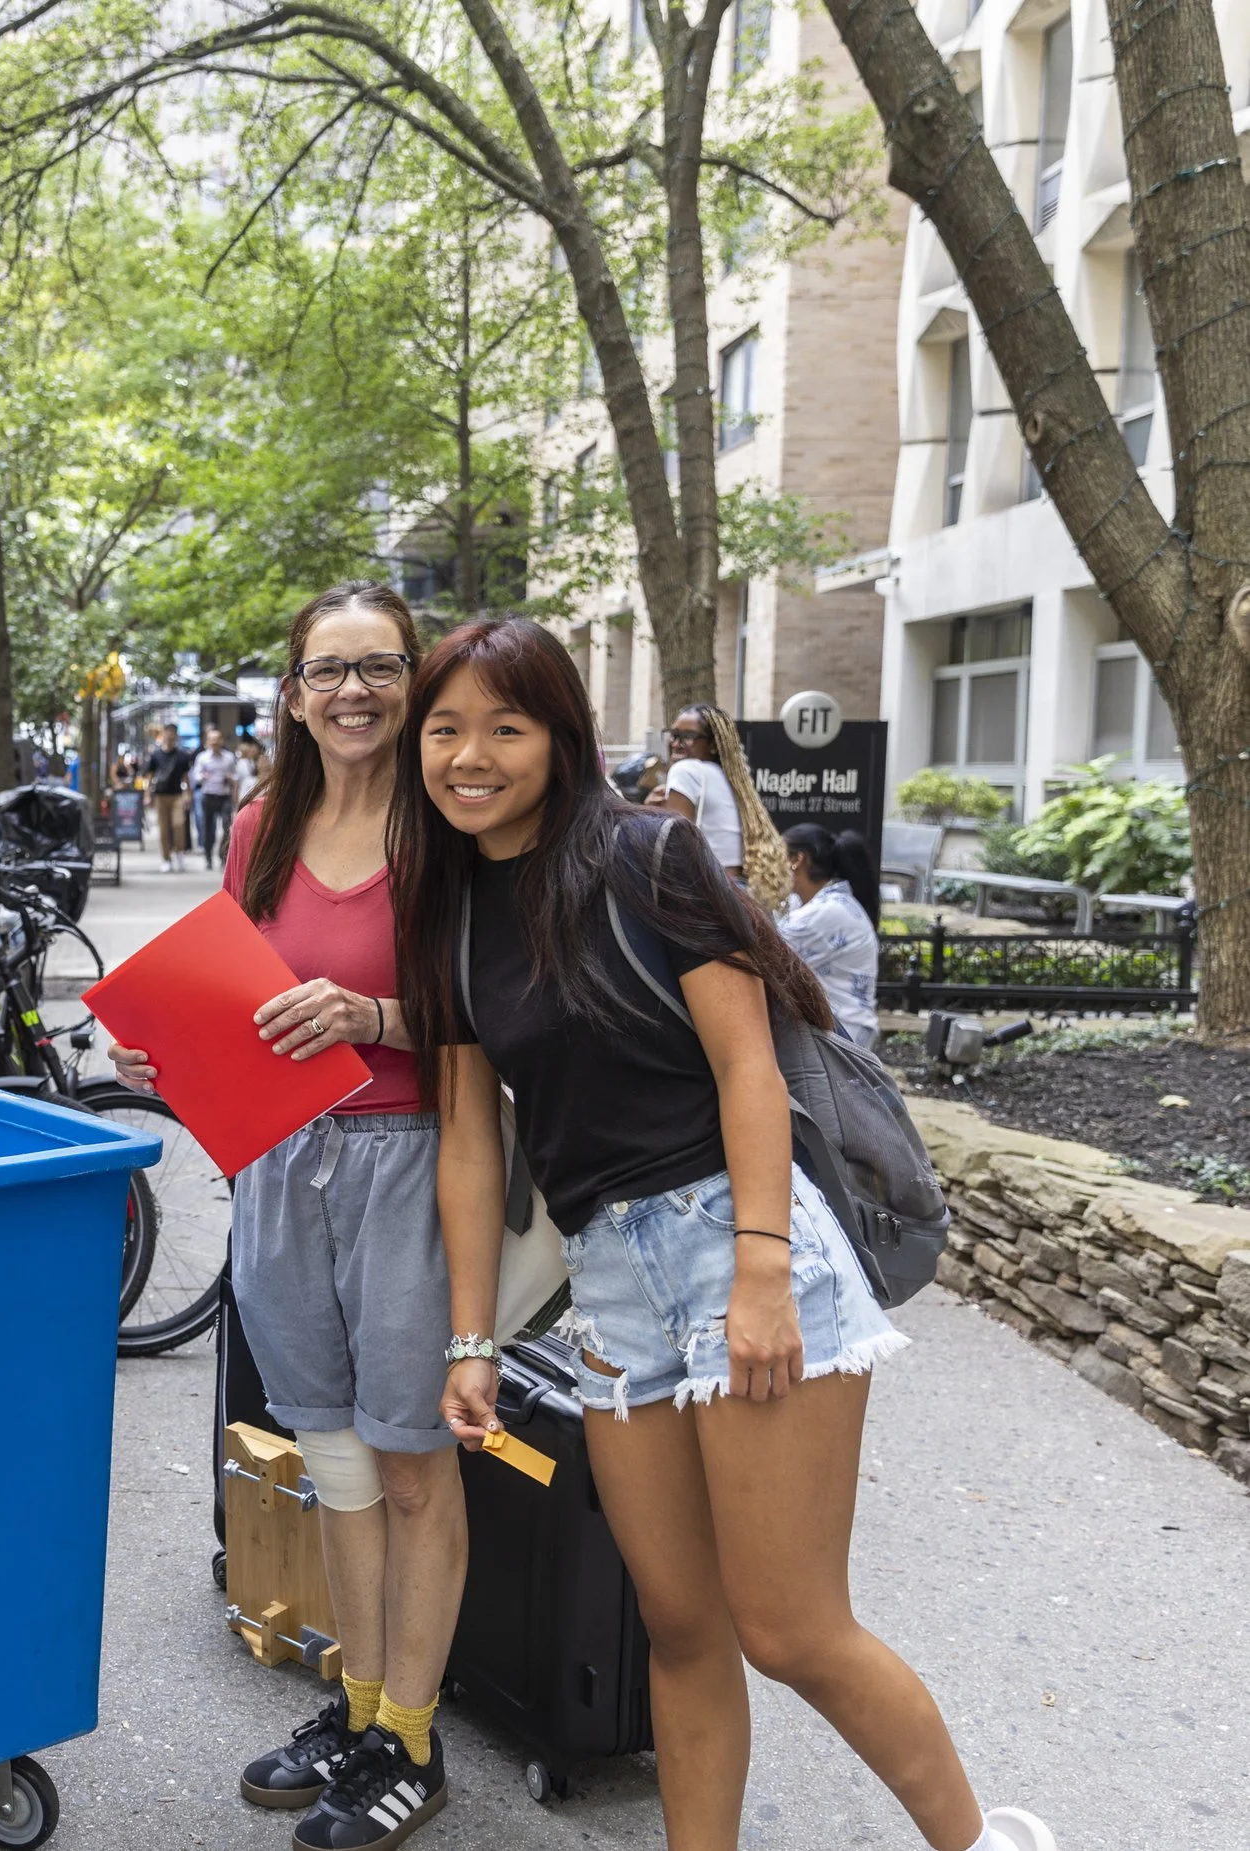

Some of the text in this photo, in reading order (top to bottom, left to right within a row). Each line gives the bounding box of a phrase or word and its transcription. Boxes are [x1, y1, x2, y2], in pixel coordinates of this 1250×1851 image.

[798, 707, 832, 735] FIT
[755, 768, 859, 797] Nagler Hall
[778, 797, 807, 813] West
[808, 797, 823, 812] 27
[823, 797, 862, 813] Street
